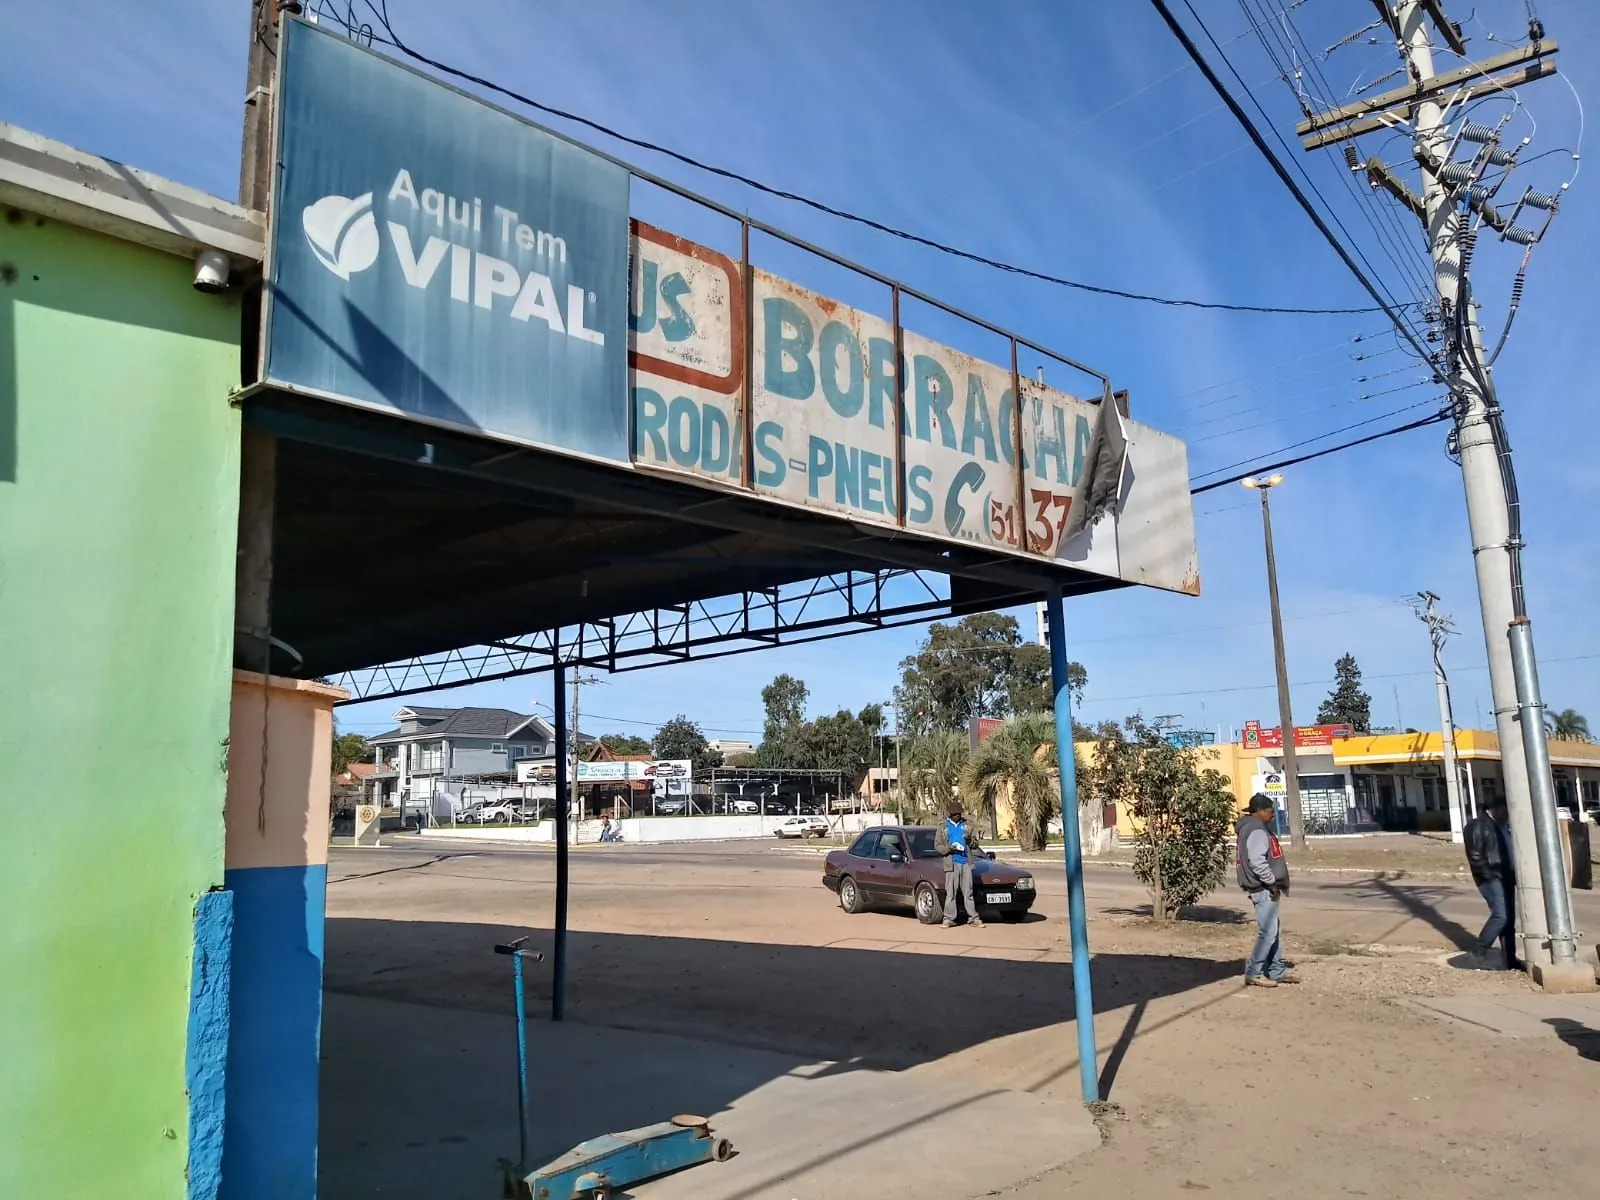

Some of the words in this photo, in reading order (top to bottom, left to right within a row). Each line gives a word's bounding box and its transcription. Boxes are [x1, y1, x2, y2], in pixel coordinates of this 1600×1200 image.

[387, 168, 482, 232] Aqui
[493, 204, 568, 263] Tem
[387, 220, 605, 347] VIPAL
